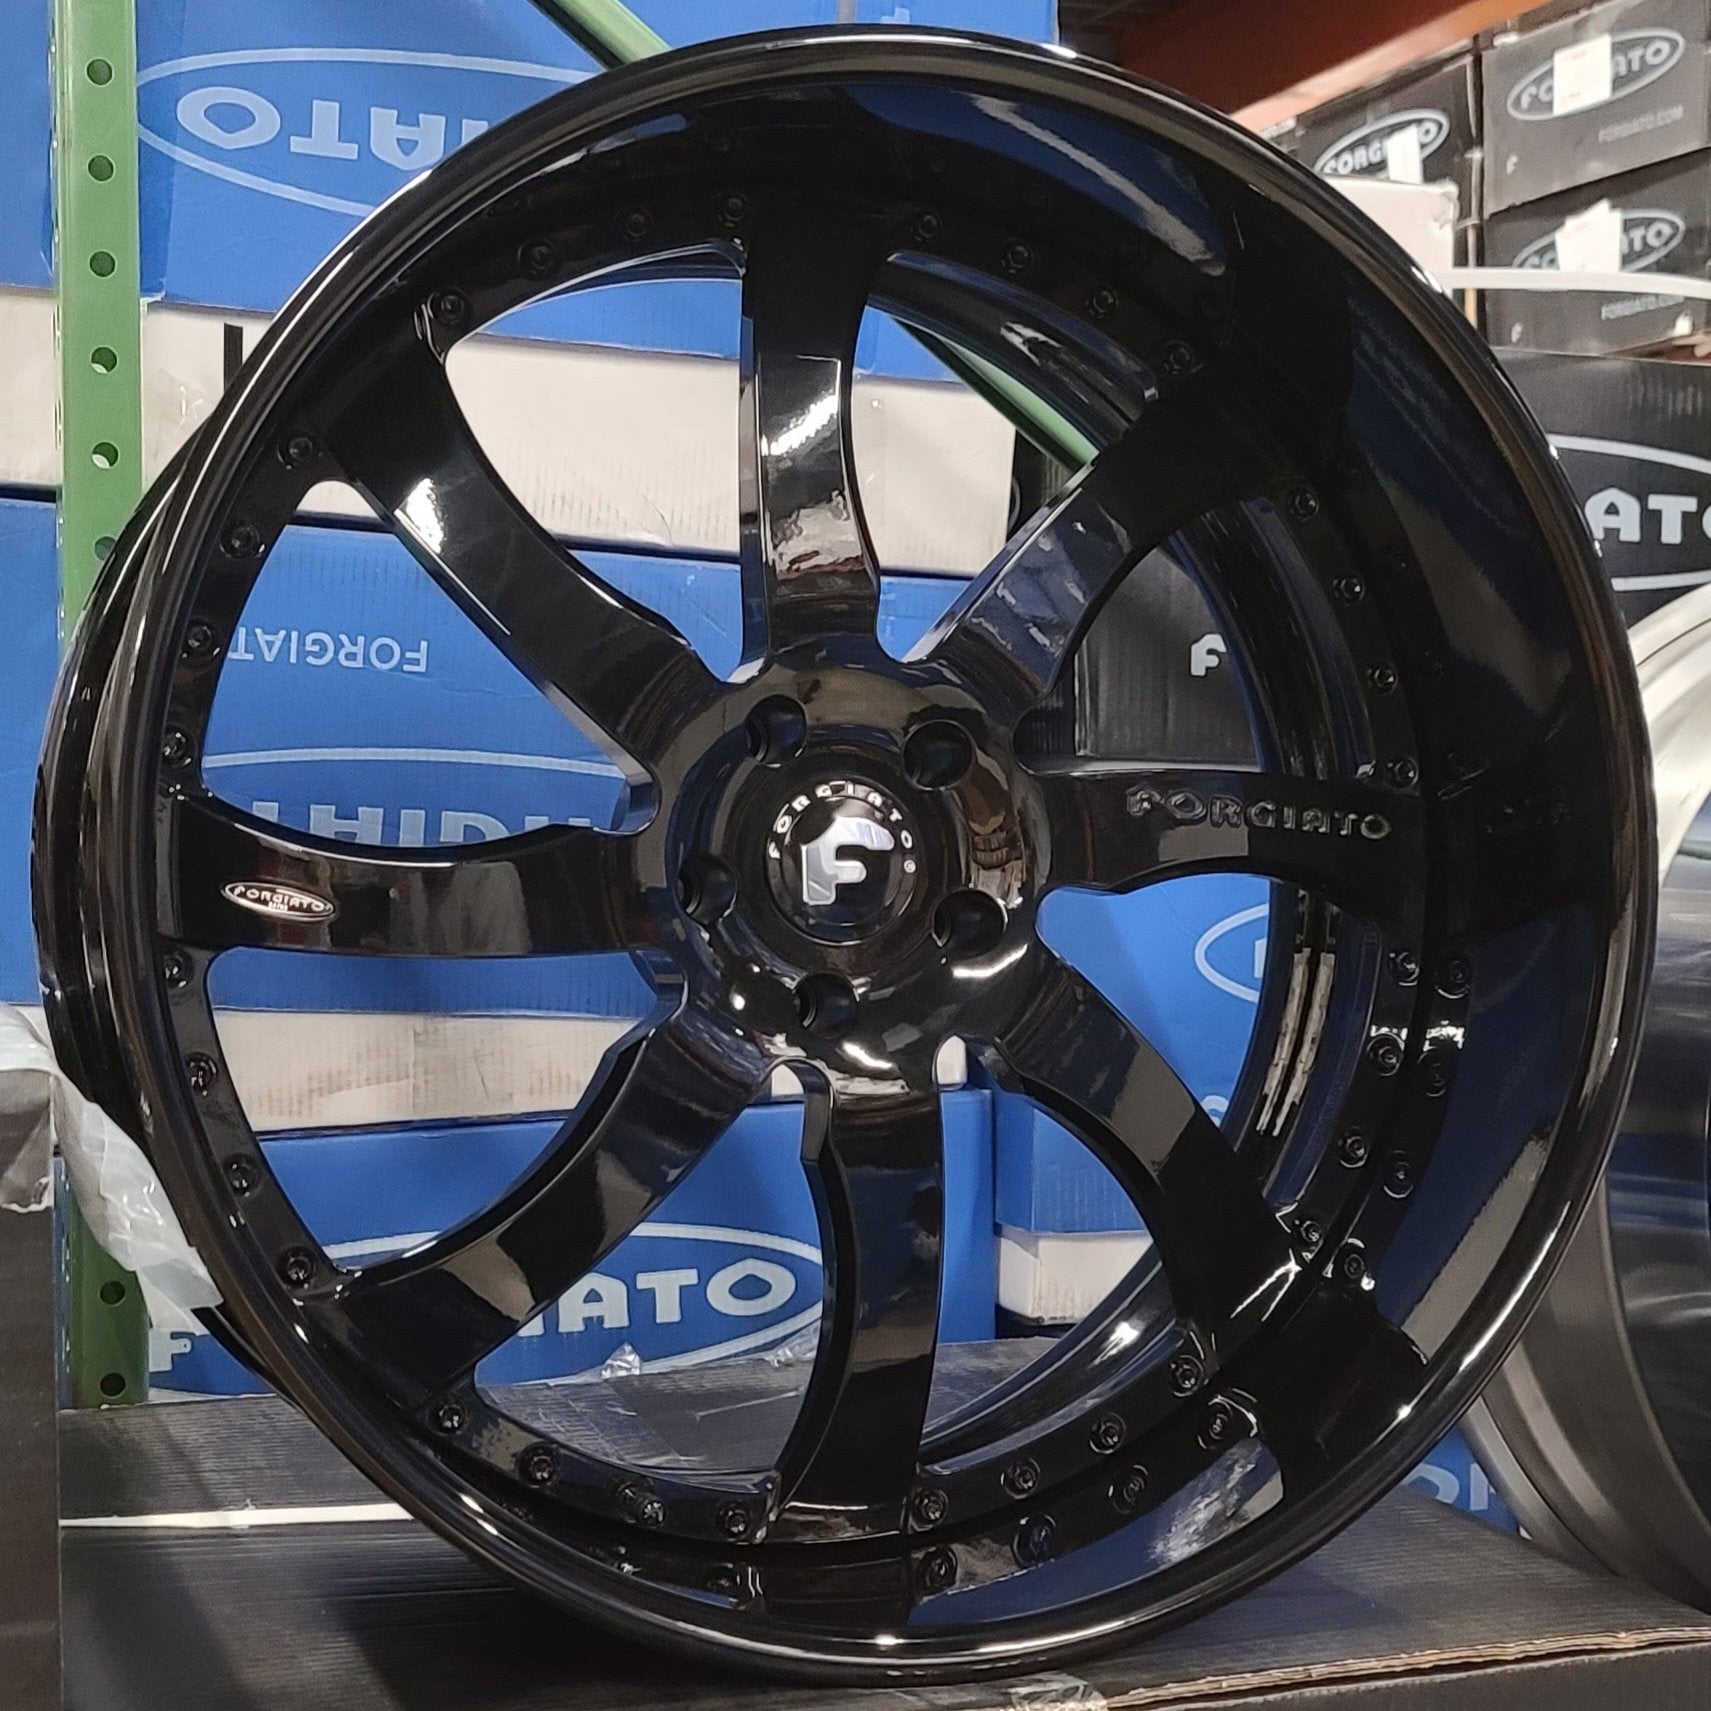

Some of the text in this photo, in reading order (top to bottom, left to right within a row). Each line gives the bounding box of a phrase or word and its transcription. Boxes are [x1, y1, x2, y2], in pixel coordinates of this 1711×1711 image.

[1584, 487, 1711, 545] AT
[1190, 633, 1227, 676] F
[768, 781, 913, 859] FORGIATO
[1126, 785, 1392, 839] FORGIATO
[801, 816, 895, 906] F
[233, 885, 326, 912] FORGIATO
[517, 1258, 797, 1338] ATO
